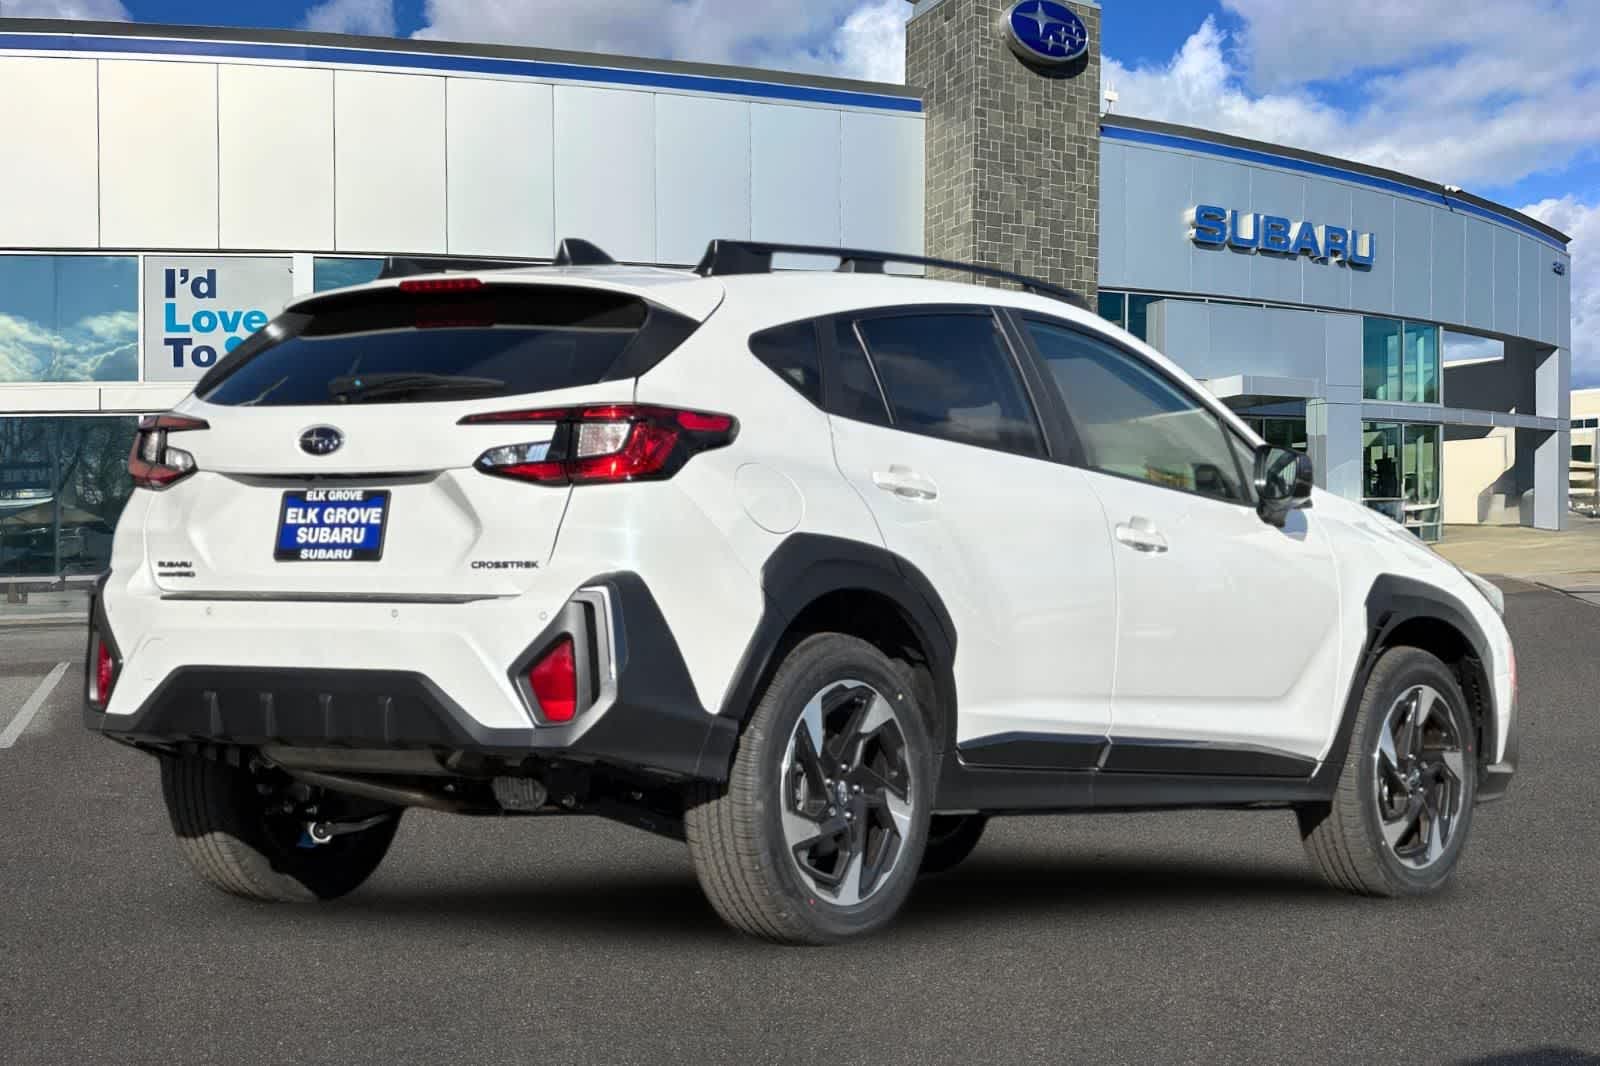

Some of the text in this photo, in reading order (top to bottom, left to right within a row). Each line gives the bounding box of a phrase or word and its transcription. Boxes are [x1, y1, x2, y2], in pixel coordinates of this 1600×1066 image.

[1189, 204, 1375, 269] SUBARU
[165, 268, 217, 299] I’d
[165, 303, 269, 333] Love
[164, 337, 217, 368] To
[306, 491, 363, 501] ELK GROVE
[286, 507, 382, 524] ELK GROVE
[296, 527, 365, 544] SUBARU
[300, 549, 352, 559] SUBARU
[471, 560, 539, 569] CROSSTREK
